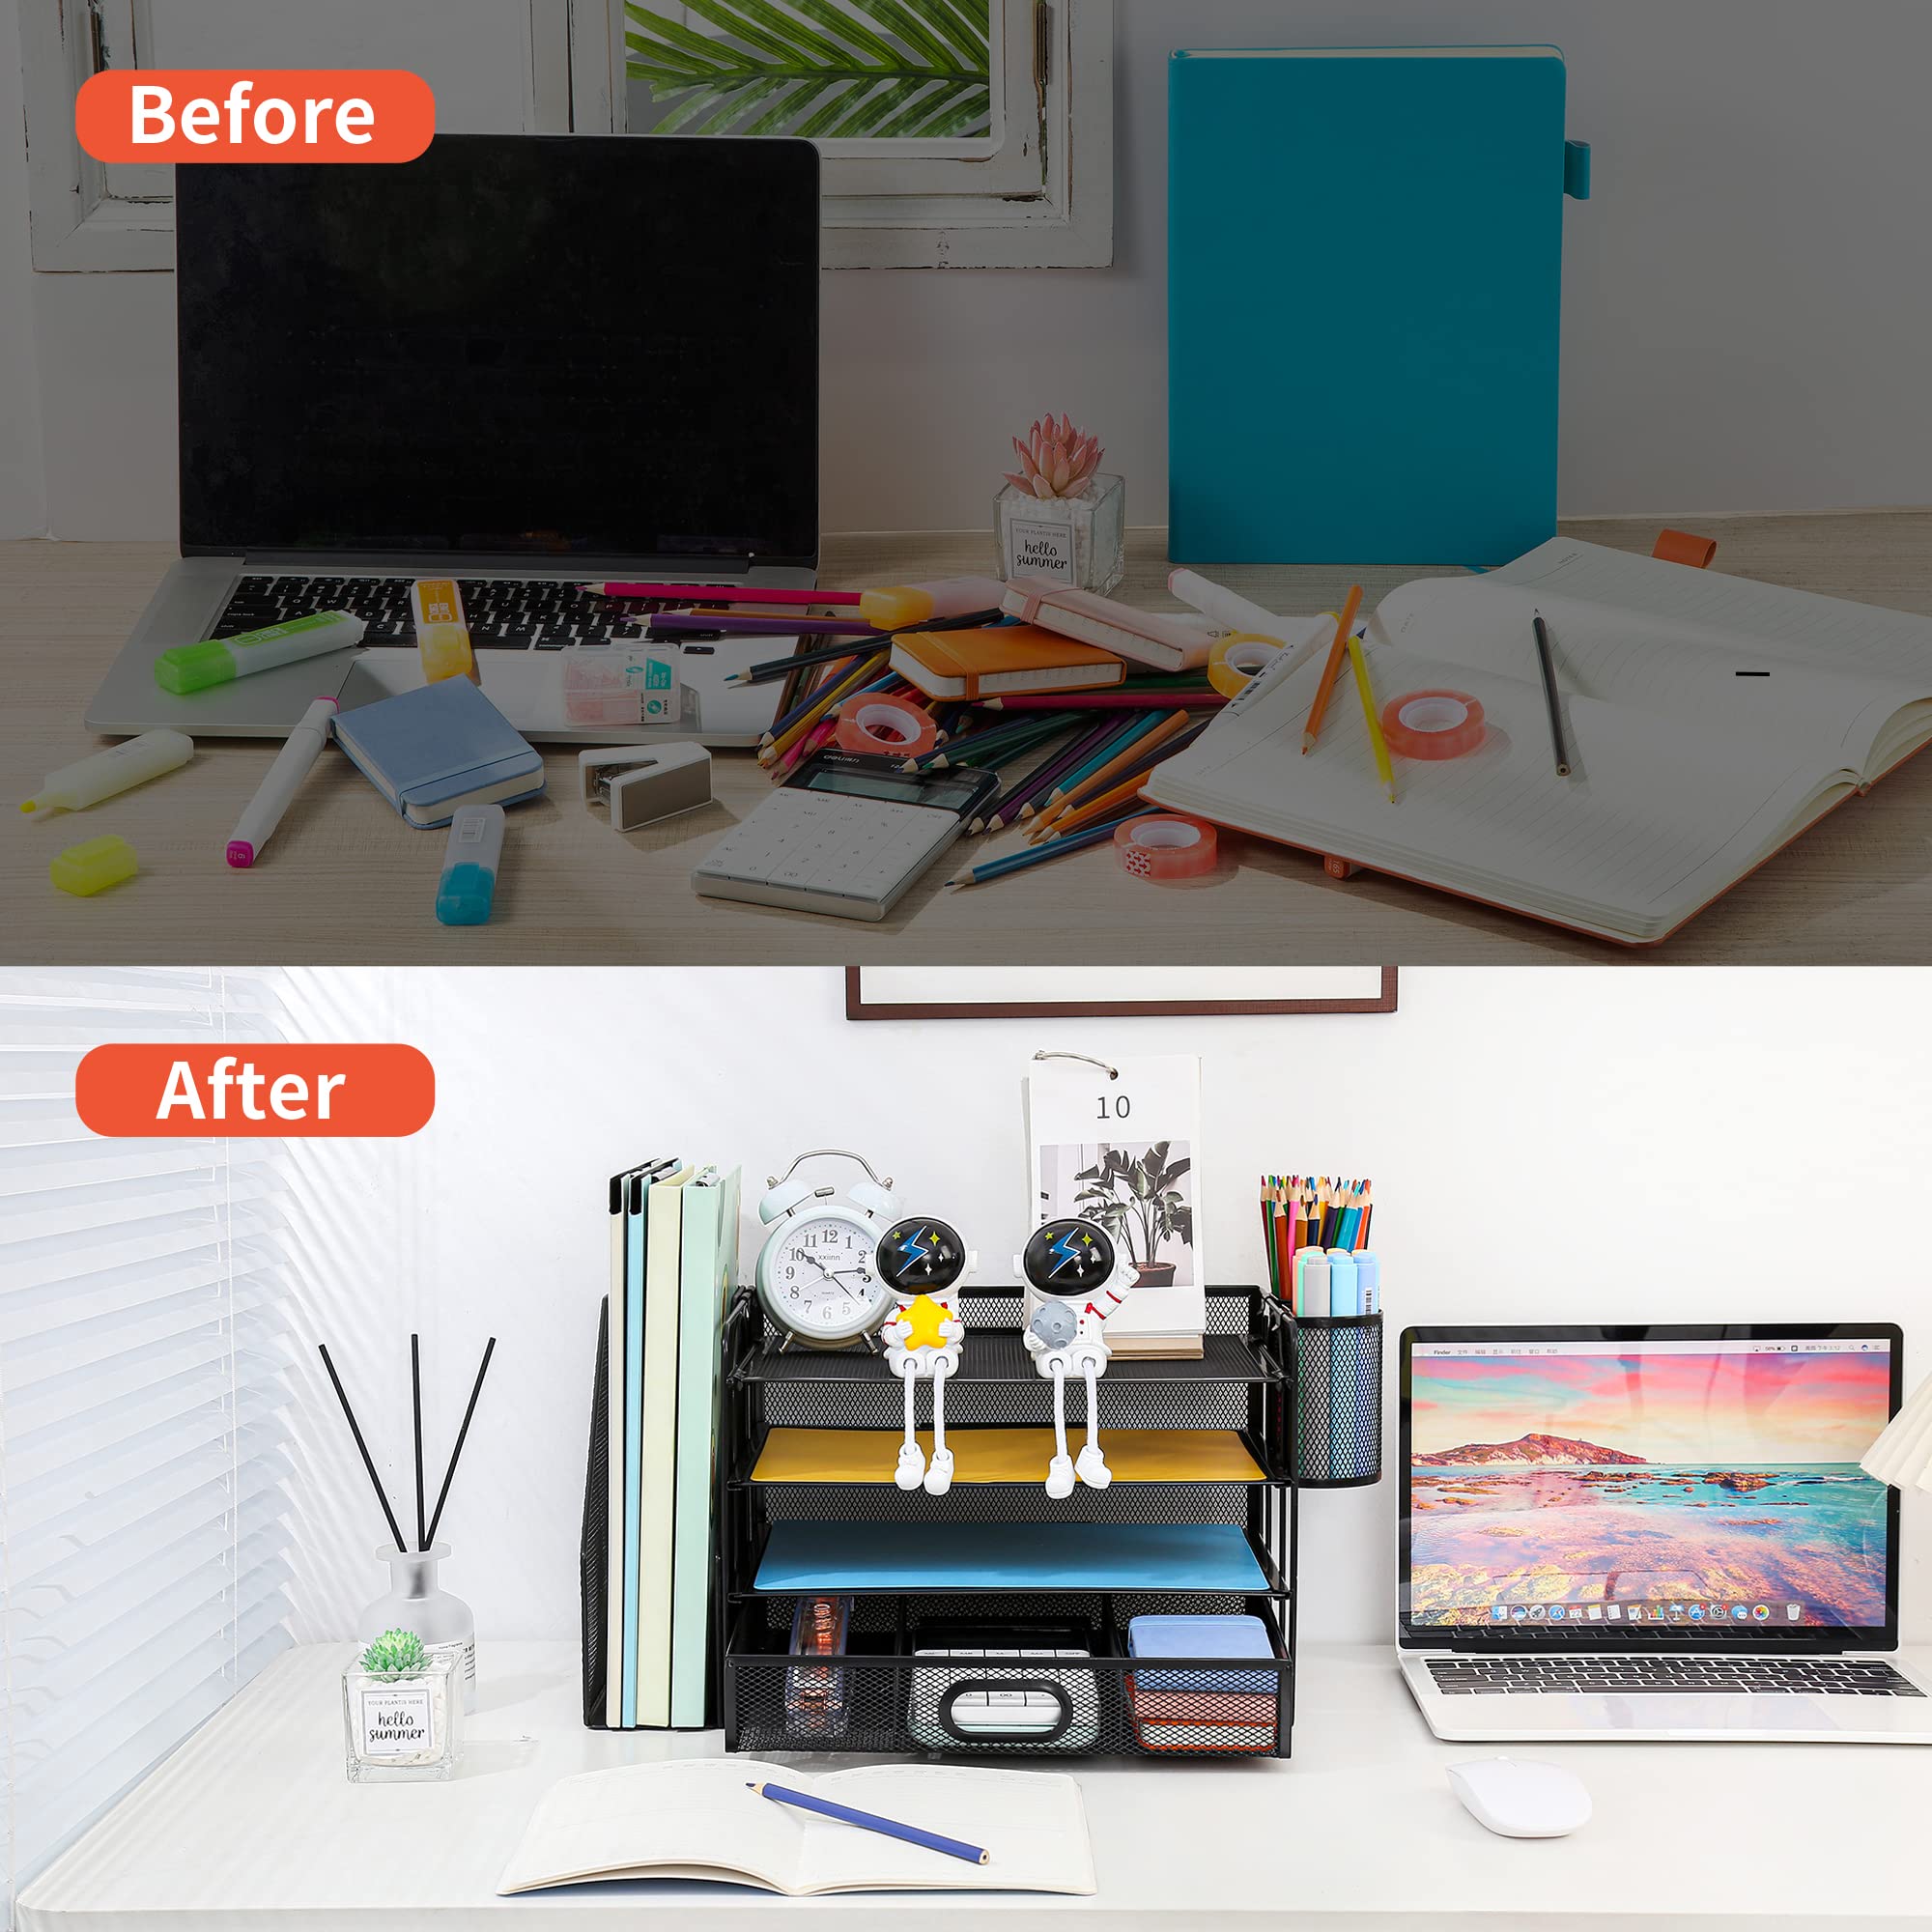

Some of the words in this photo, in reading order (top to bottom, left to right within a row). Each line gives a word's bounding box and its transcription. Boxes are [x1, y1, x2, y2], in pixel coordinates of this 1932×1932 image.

[1024, 539, 1058, 557] hello
[1016, 554, 1067, 570] summer
[1096, 1095, 1130, 1119] 10
[803, 1234, 817, 1247] 11
[845, 1236, 853, 1249] 1
[821, 1229, 838, 1243] 12
[789, 1247, 805, 1262] 10
[858, 1250, 867, 1264] 2
[785, 1265, 795, 1280] 9
[790, 1285, 800, 1299] 8
[804, 1299, 812, 1314] 7
[842, 1301, 851, 1315] 5
[822, 1306, 832, 1320] 6
[378, 1710, 413, 1727] hello
[369, 1728, 425, 1743] summer
